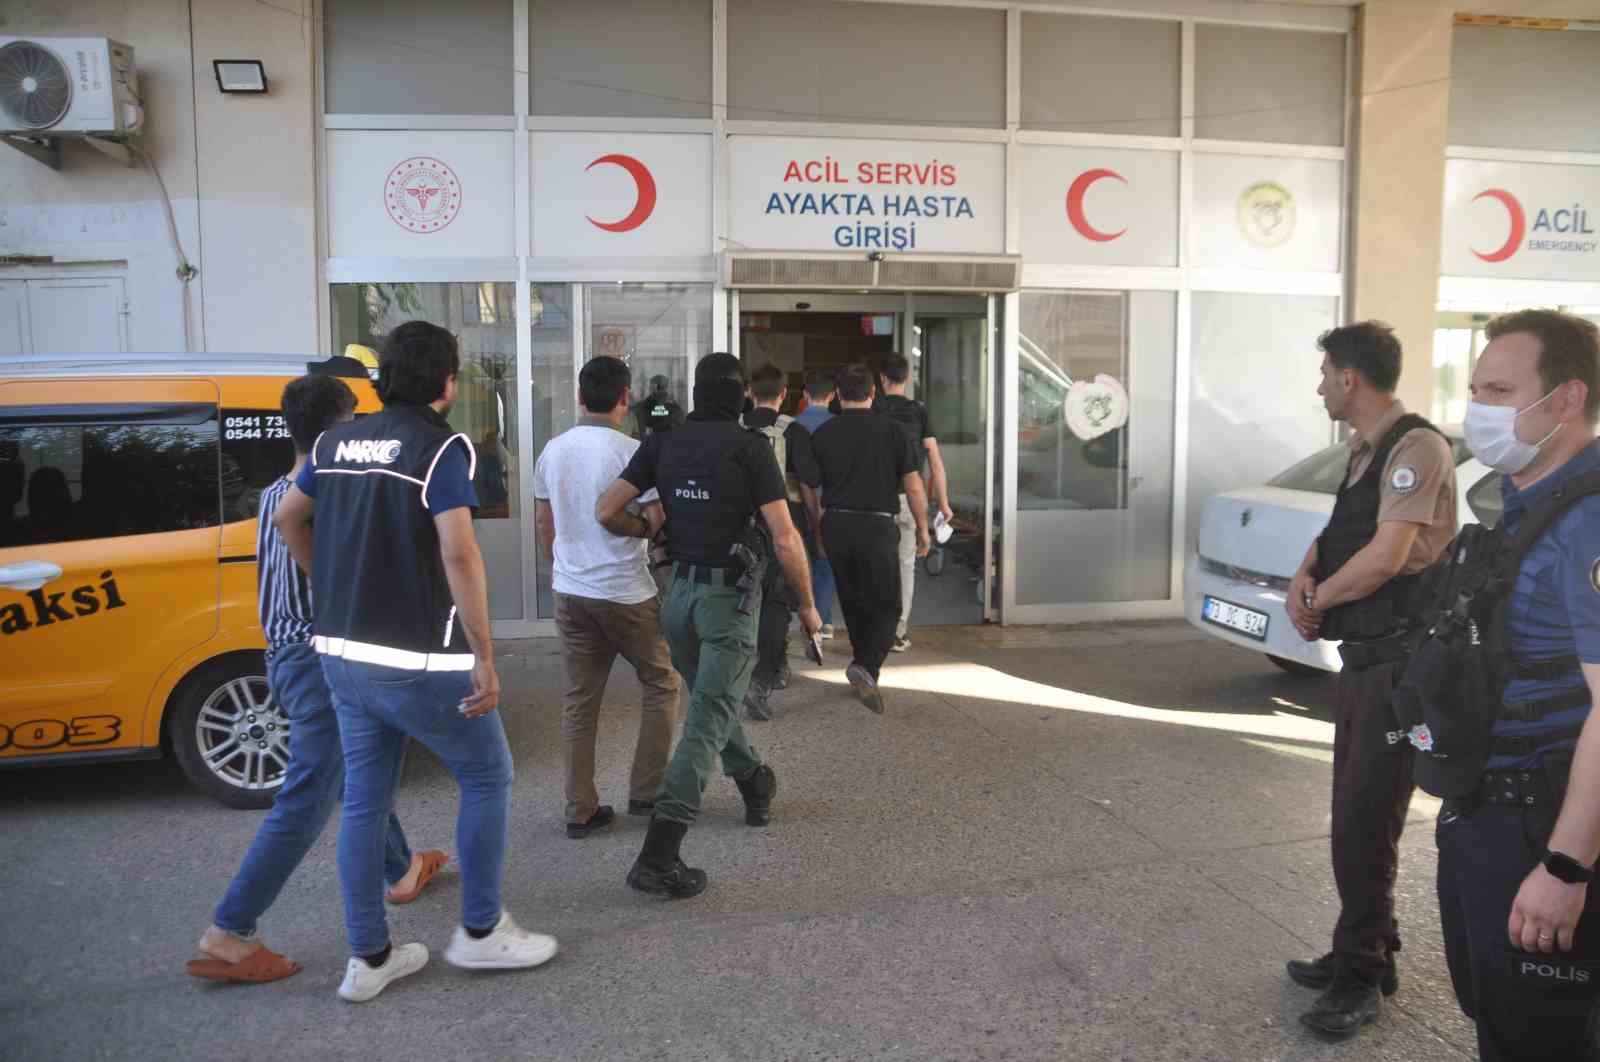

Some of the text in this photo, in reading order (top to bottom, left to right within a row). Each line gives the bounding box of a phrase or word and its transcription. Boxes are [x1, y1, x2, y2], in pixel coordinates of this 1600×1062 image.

[784, 156, 956, 186] ACİL SERVİS
[765, 192, 974, 218] AYAKTA HASTA
[1533, 203, 1594, 234] ACİL
[834, 221, 916, 251] GİRİŞİ
[1528, 239, 1597, 253] EMERGENCY
[224, 428, 261, 440] 0544
[225, 416, 260, 428] 0541
